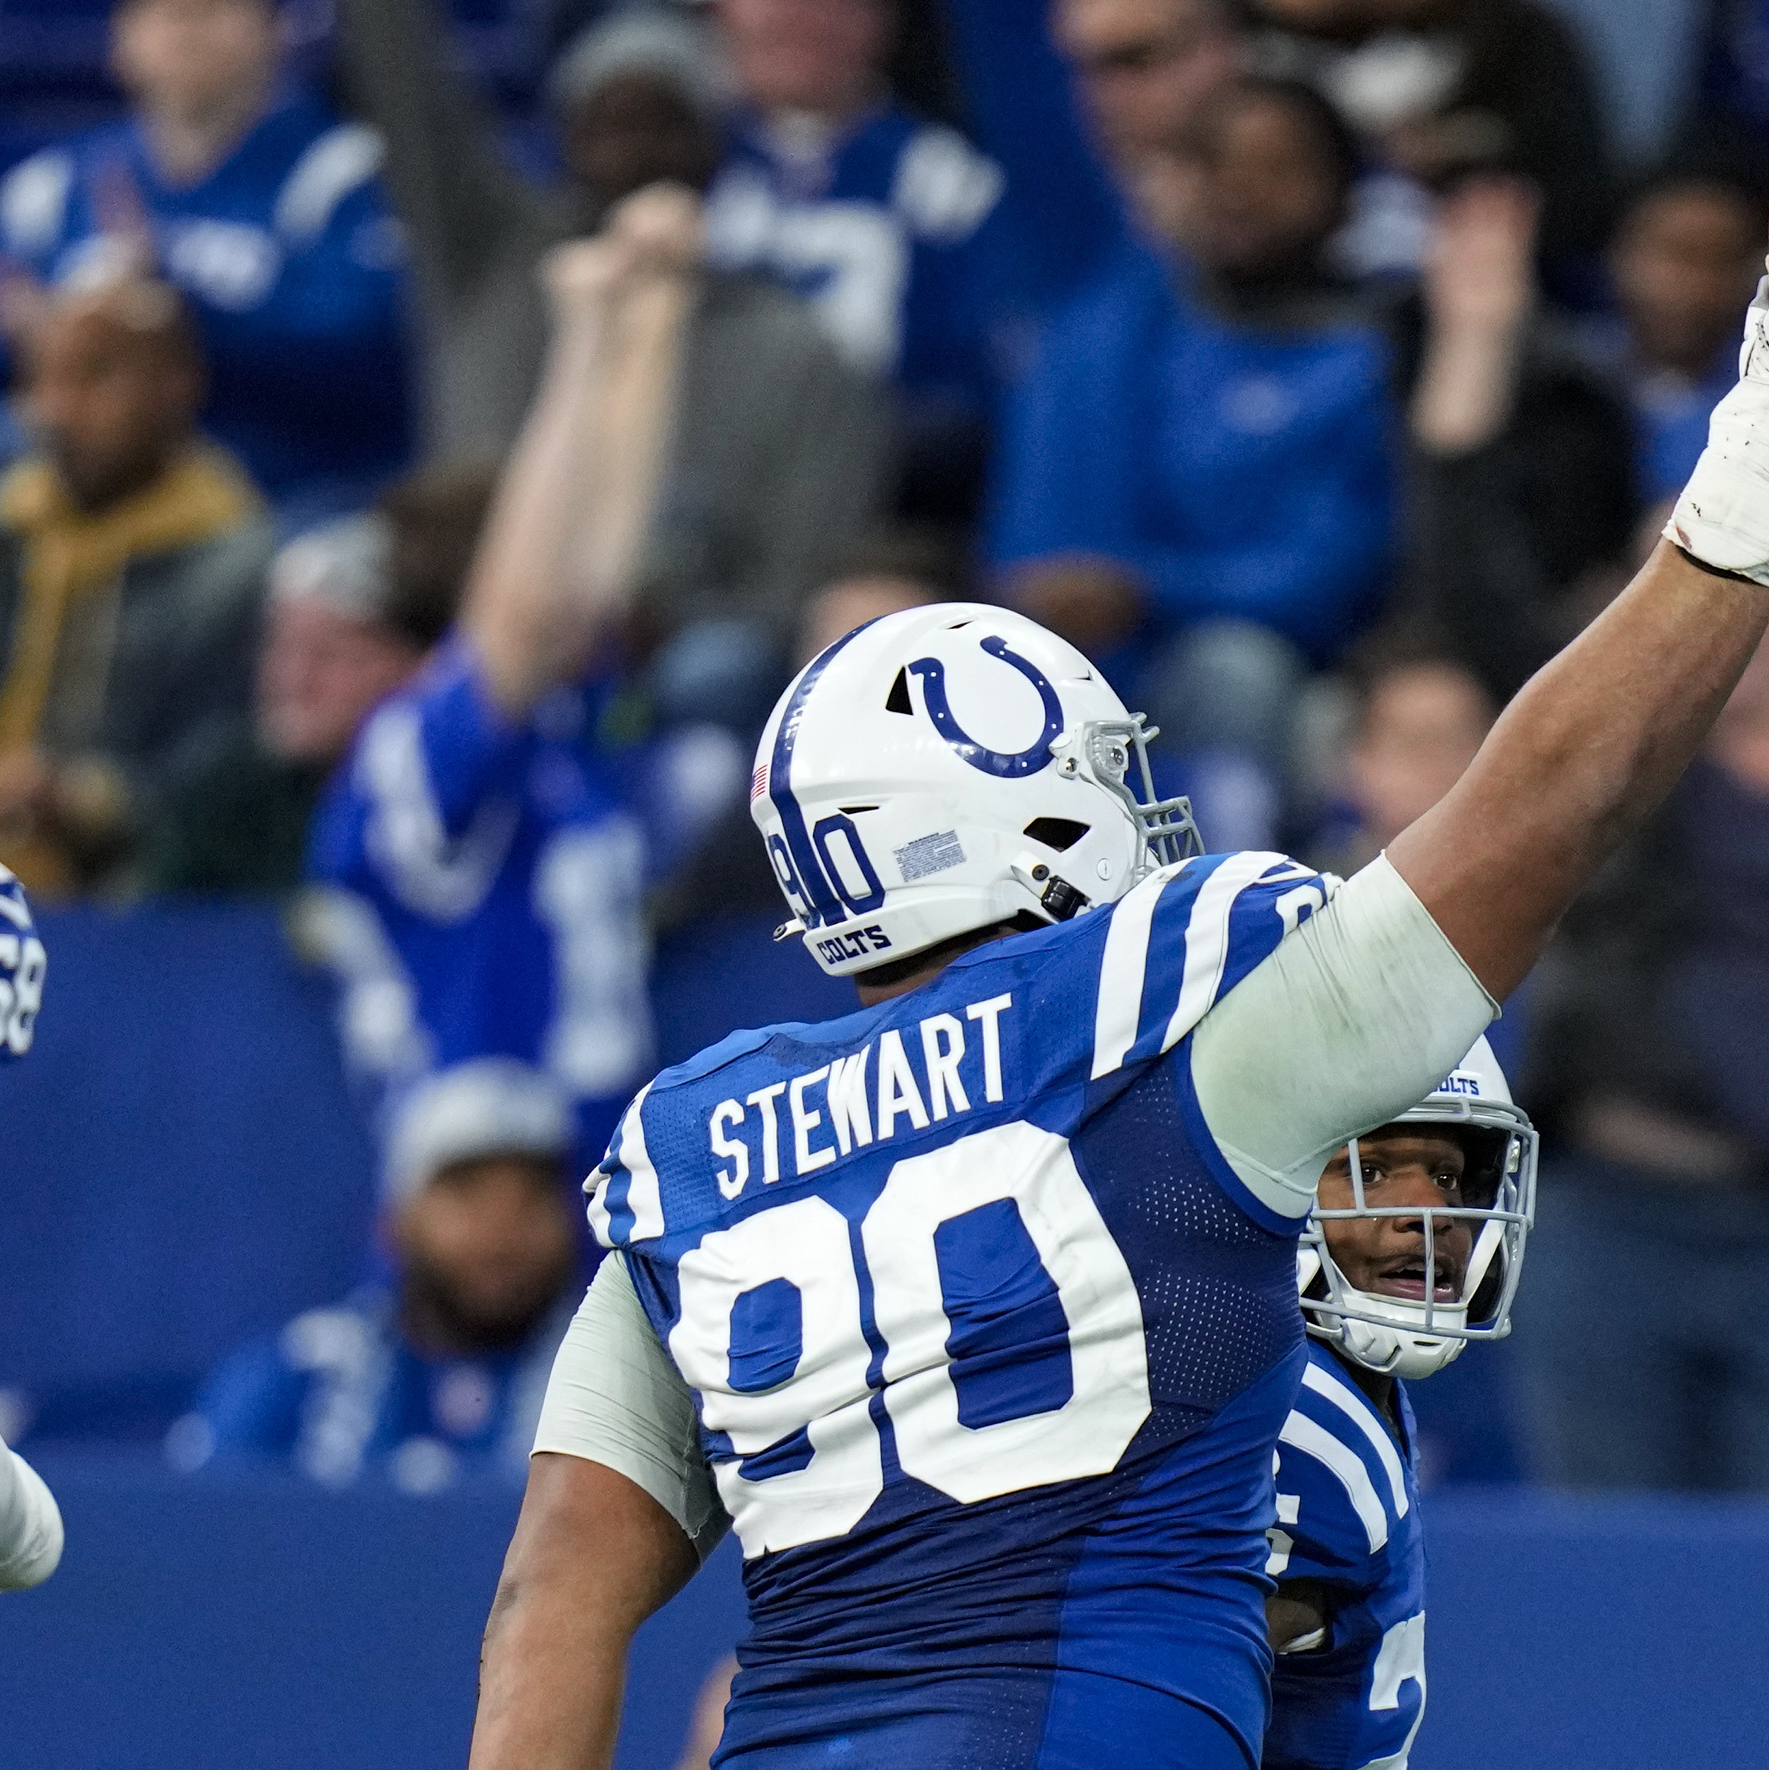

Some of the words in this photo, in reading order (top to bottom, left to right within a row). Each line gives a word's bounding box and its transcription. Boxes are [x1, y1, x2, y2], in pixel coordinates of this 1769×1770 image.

[768, 814, 886, 930] 90
[816, 925, 892, 964] COLTS
[709, 993, 1012, 1200] STEWART
[669, 1120, 1152, 1560] 90
